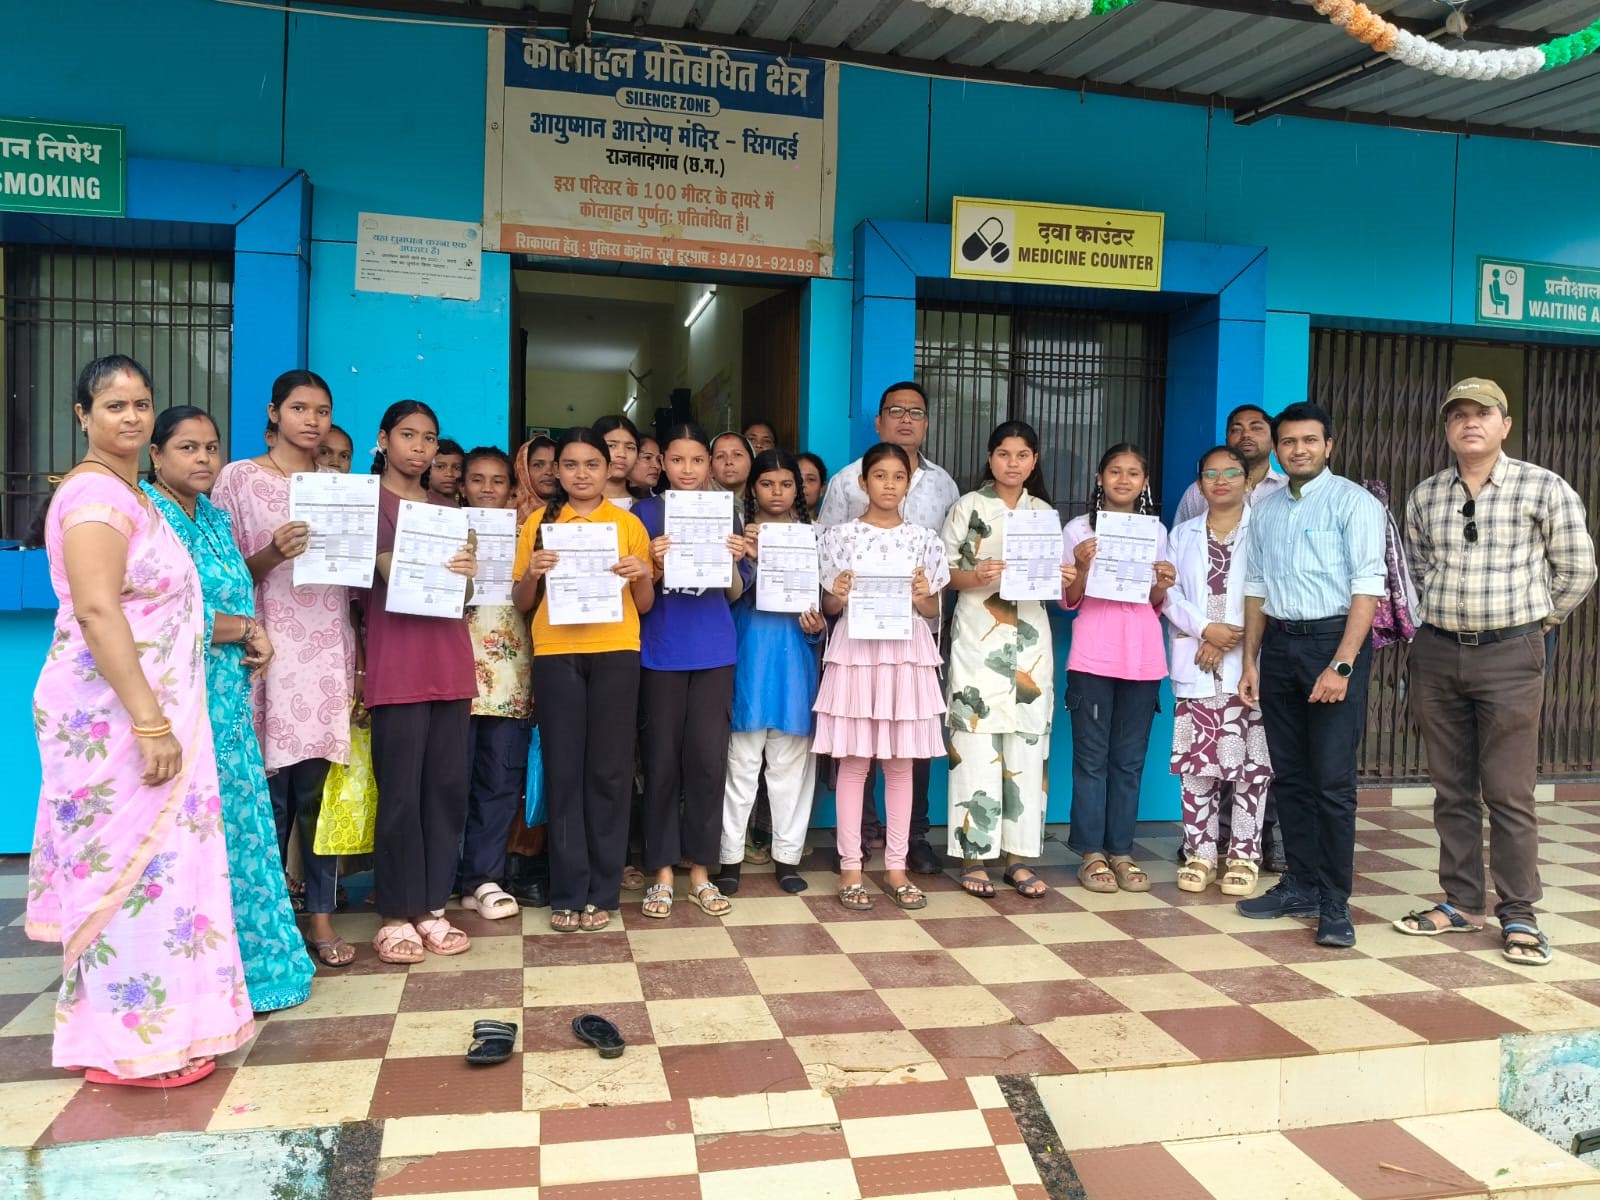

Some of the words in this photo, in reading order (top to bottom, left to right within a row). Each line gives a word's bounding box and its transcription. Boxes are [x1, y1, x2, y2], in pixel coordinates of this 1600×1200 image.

[643, 41, 758, 93] प्रतिबंधित
[766, 56, 810, 98] क्षेत्र
[625, 91, 678, 110] SILENCE
[680, 96, 712, 113] ZONE
[36, 132, 103, 165] निषेध
[530, 112, 607, 144] आयुष्मान
[612, 116, 673, 145] आरोग्य
[678, 119, 721, 152] मंदिर
[742, 127, 800, 160] सिंगदई
[606, 145, 679, 171] राजनांदगांव
[683, 155, 726, 178] (छ.ग.)
[0, 171, 101, 200] MOKING
[553, 175, 576, 193] इस
[579, 174, 622, 196] परिसर
[626, 177, 639, 197] के
[644, 182, 677, 201] 100
[681, 183, 713, 204] मीटर
[715, 186, 728, 206] के
[731, 189, 761, 209] दायरे
[764, 190, 775, 210] में
[579, 199, 634, 222] कोलाहल
[677, 206, 733, 230] प्रतिबंधित
[1038, 222, 1072, 244] दवा
[1075, 220, 1135, 247] काउंटर
[515, 231, 560, 252] शिकायत
[563, 236, 580, 257] हेतु
[589, 238, 621, 259] पुलिस
[624, 239, 654, 260] कंट्रोल
[719, 252, 815, 273] 94791-92199
[1018, 246, 1087, 266] MEDICINE
[1090, 251, 1154, 271] COUNTER
[1544, 276, 1600, 299] प्रतीक्षाल
[1528, 300, 1587, 322] WAITING
